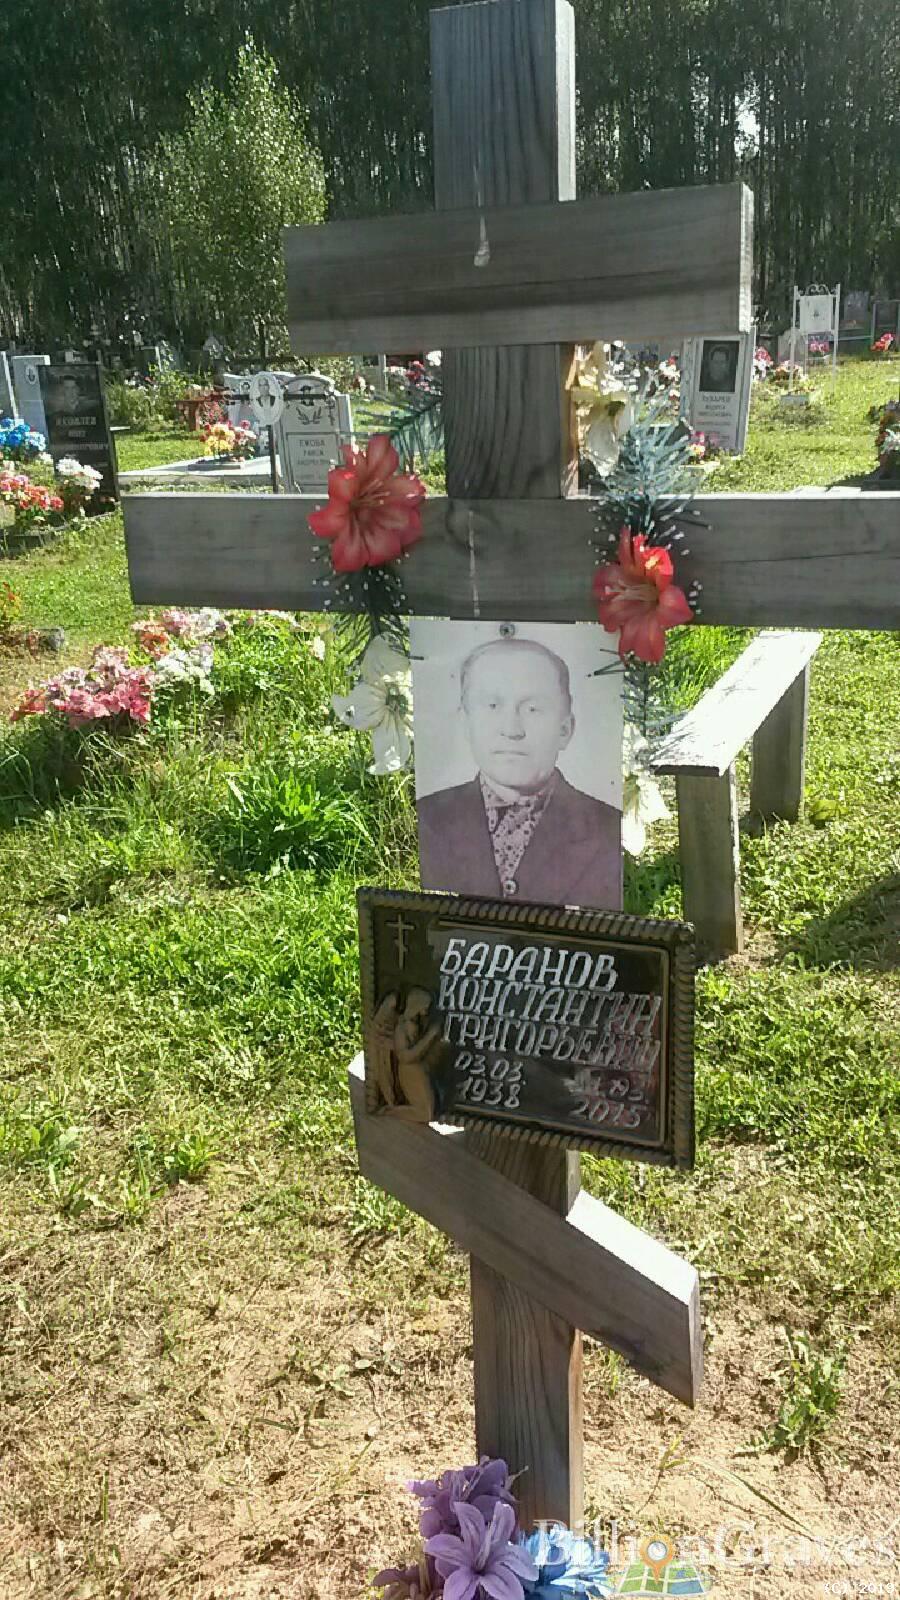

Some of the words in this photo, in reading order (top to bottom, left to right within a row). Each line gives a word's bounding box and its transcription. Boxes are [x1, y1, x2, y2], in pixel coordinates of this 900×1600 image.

[439, 938, 618, 992] БАРАНОВ
[438, 974, 662, 1036] КОНСТАНТИН
[457, 1075, 521, 1109] 1938
